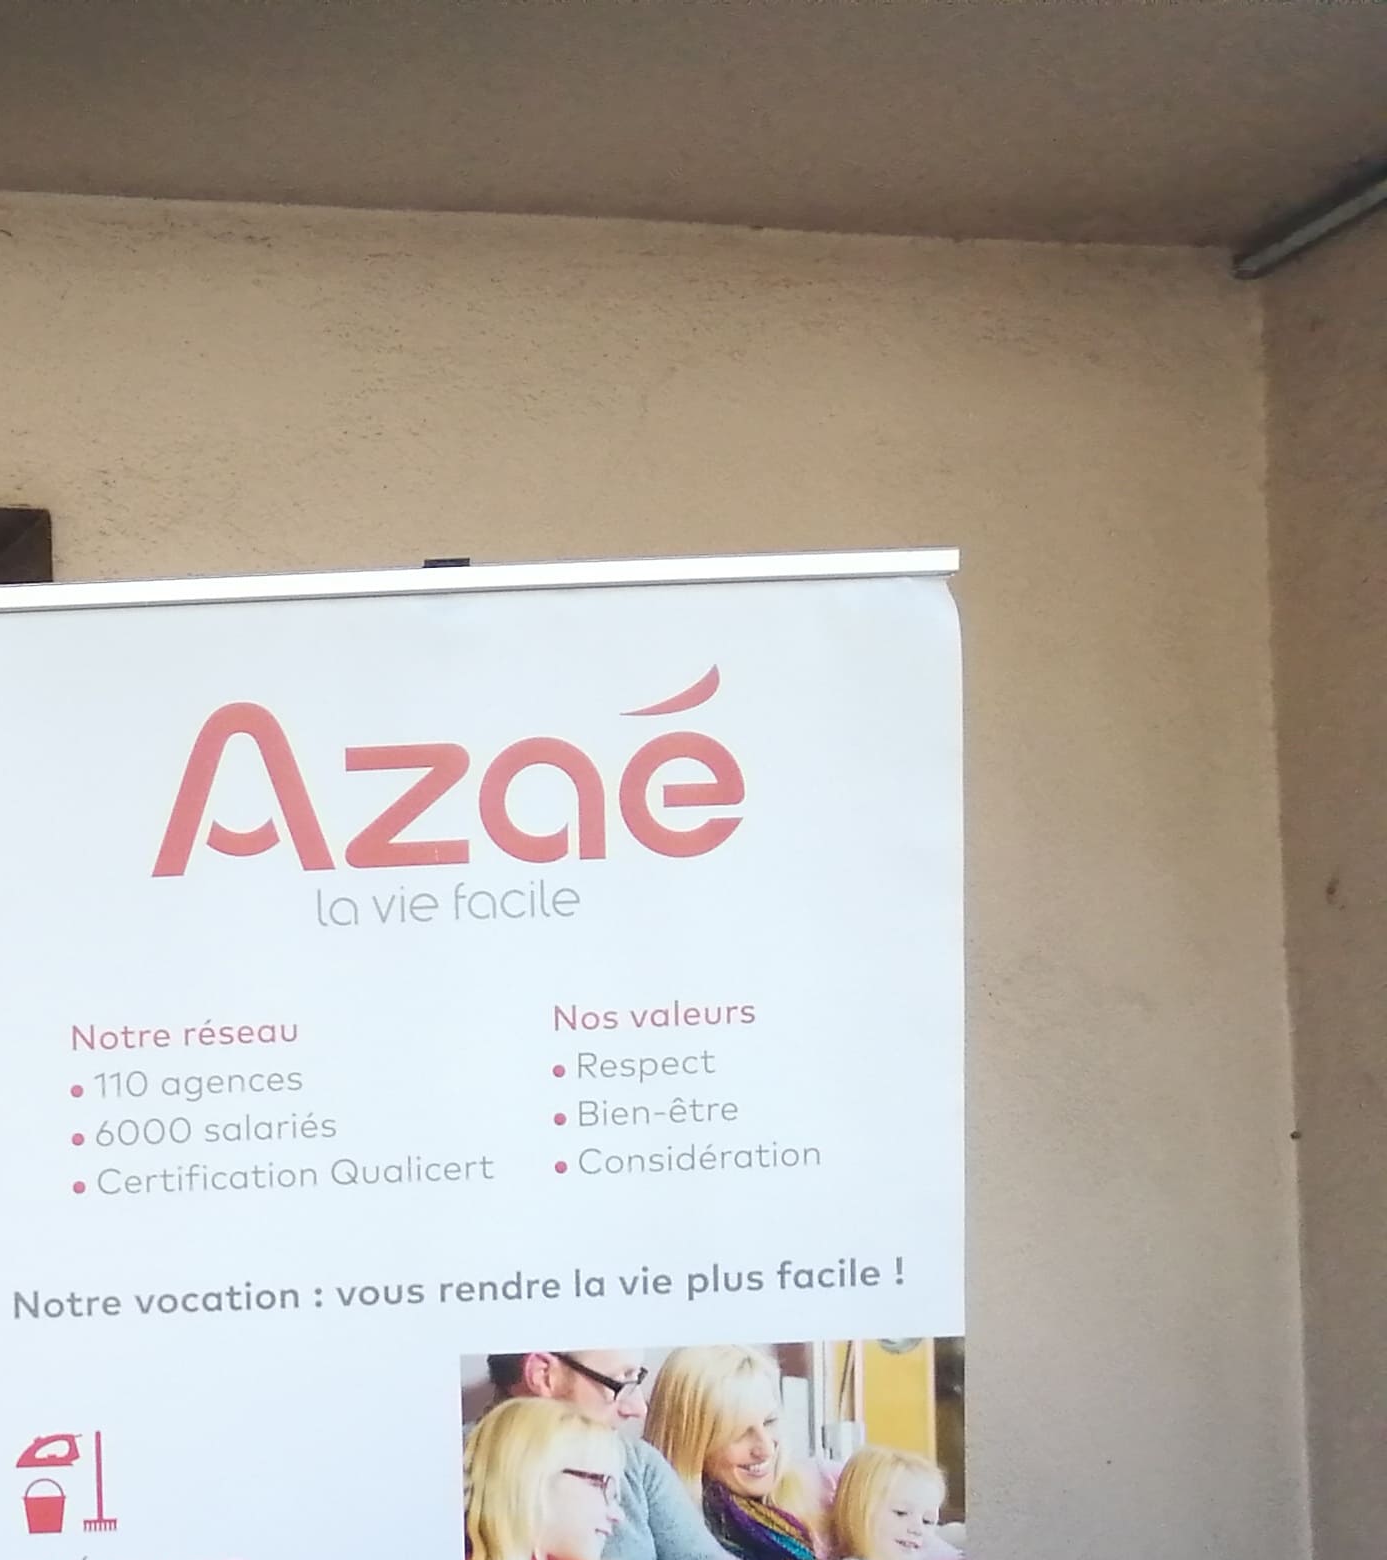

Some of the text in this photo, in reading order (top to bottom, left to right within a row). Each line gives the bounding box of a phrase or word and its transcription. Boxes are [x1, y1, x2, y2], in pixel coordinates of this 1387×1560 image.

[152, 664, 745, 877] Azaé
[317, 880, 580, 926] la vie facile
[555, 1000, 755, 1031] Nos valeurs
[72, 1019, 297, 1051] Notre réseau
[578, 1050, 715, 1083] Respect
[94, 1071, 302, 1102] 110 agences
[579, 1097, 738, 1126] Bien-être
[96, 1112, 336, 1147] 6000 salariés
[579, 1141, 820, 1174] Considération
[98, 1156, 494, 1195] Certification Qualicert
[14, 1257, 903, 1319] Notre vocation : vous rendre la vie plus facile !
